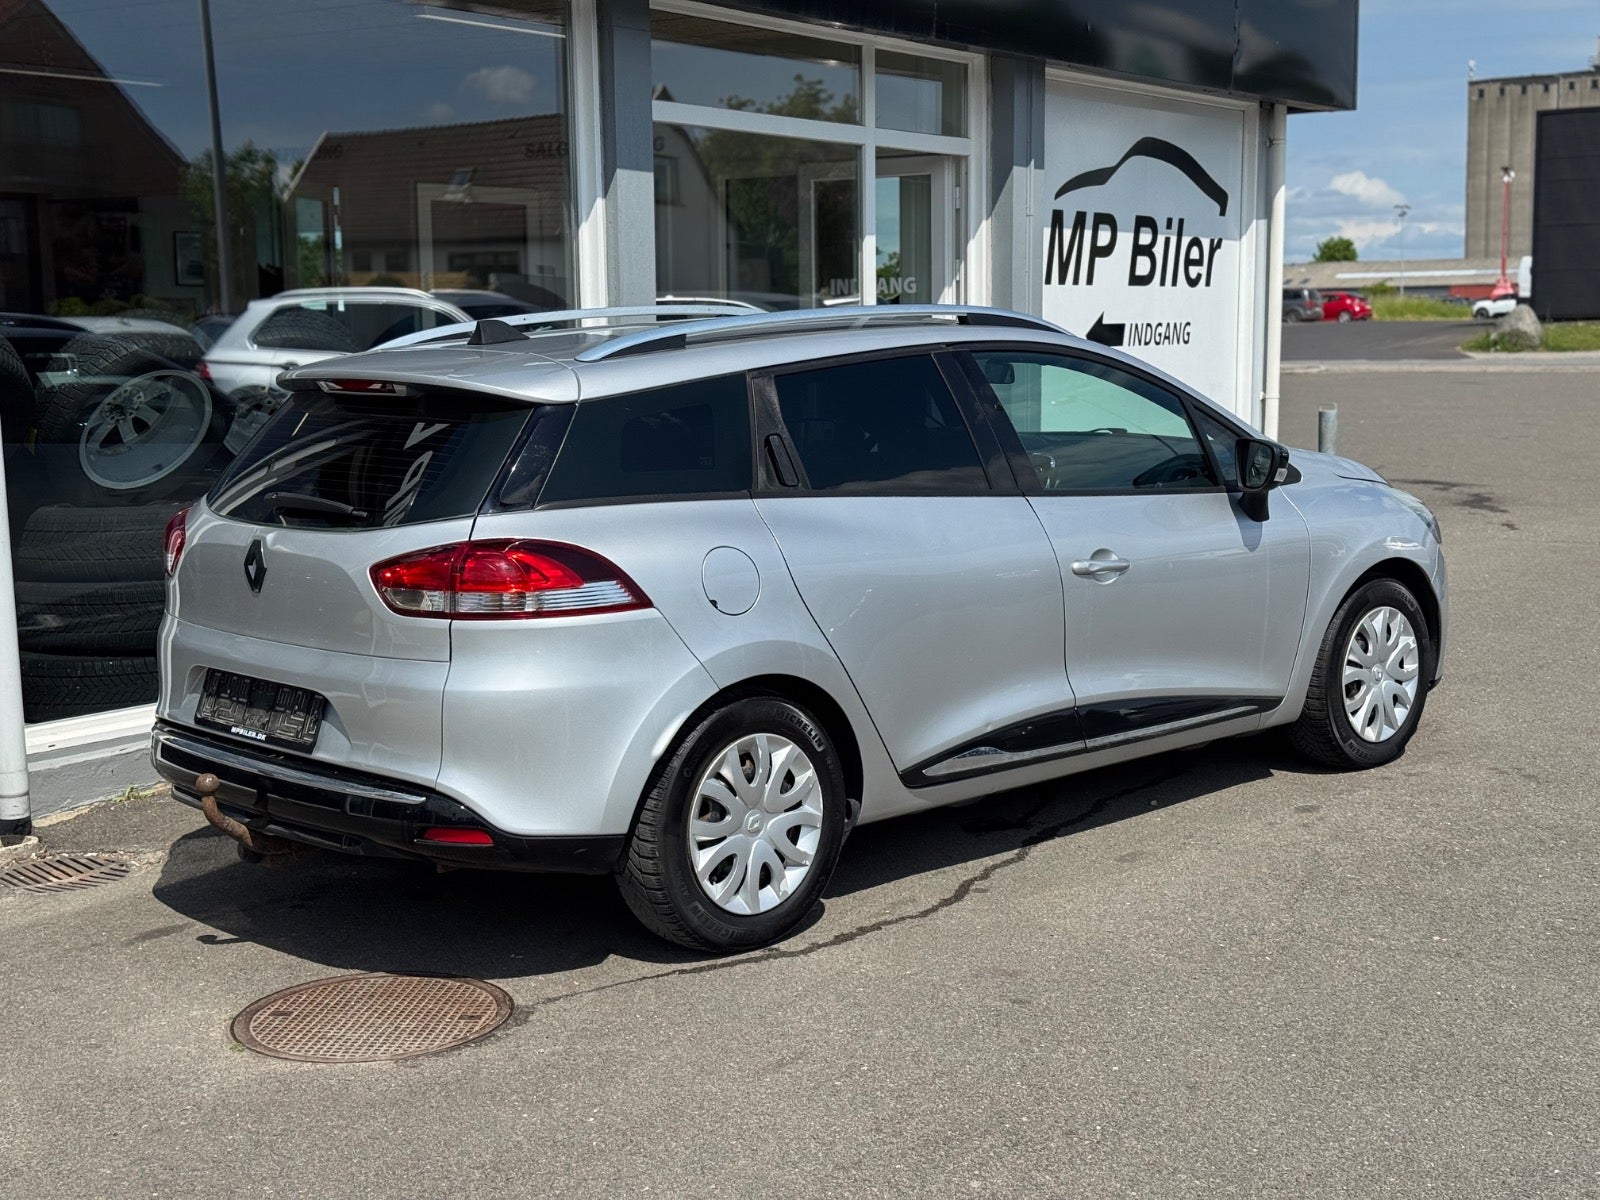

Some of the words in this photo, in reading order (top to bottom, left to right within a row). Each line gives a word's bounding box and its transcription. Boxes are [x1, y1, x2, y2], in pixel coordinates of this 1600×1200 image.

[1044, 209, 1118, 286] MP
[1128, 215, 1223, 288] Biler
[830, 276, 917, 295] INDANG
[1128, 321, 1192, 347] INDGANG
